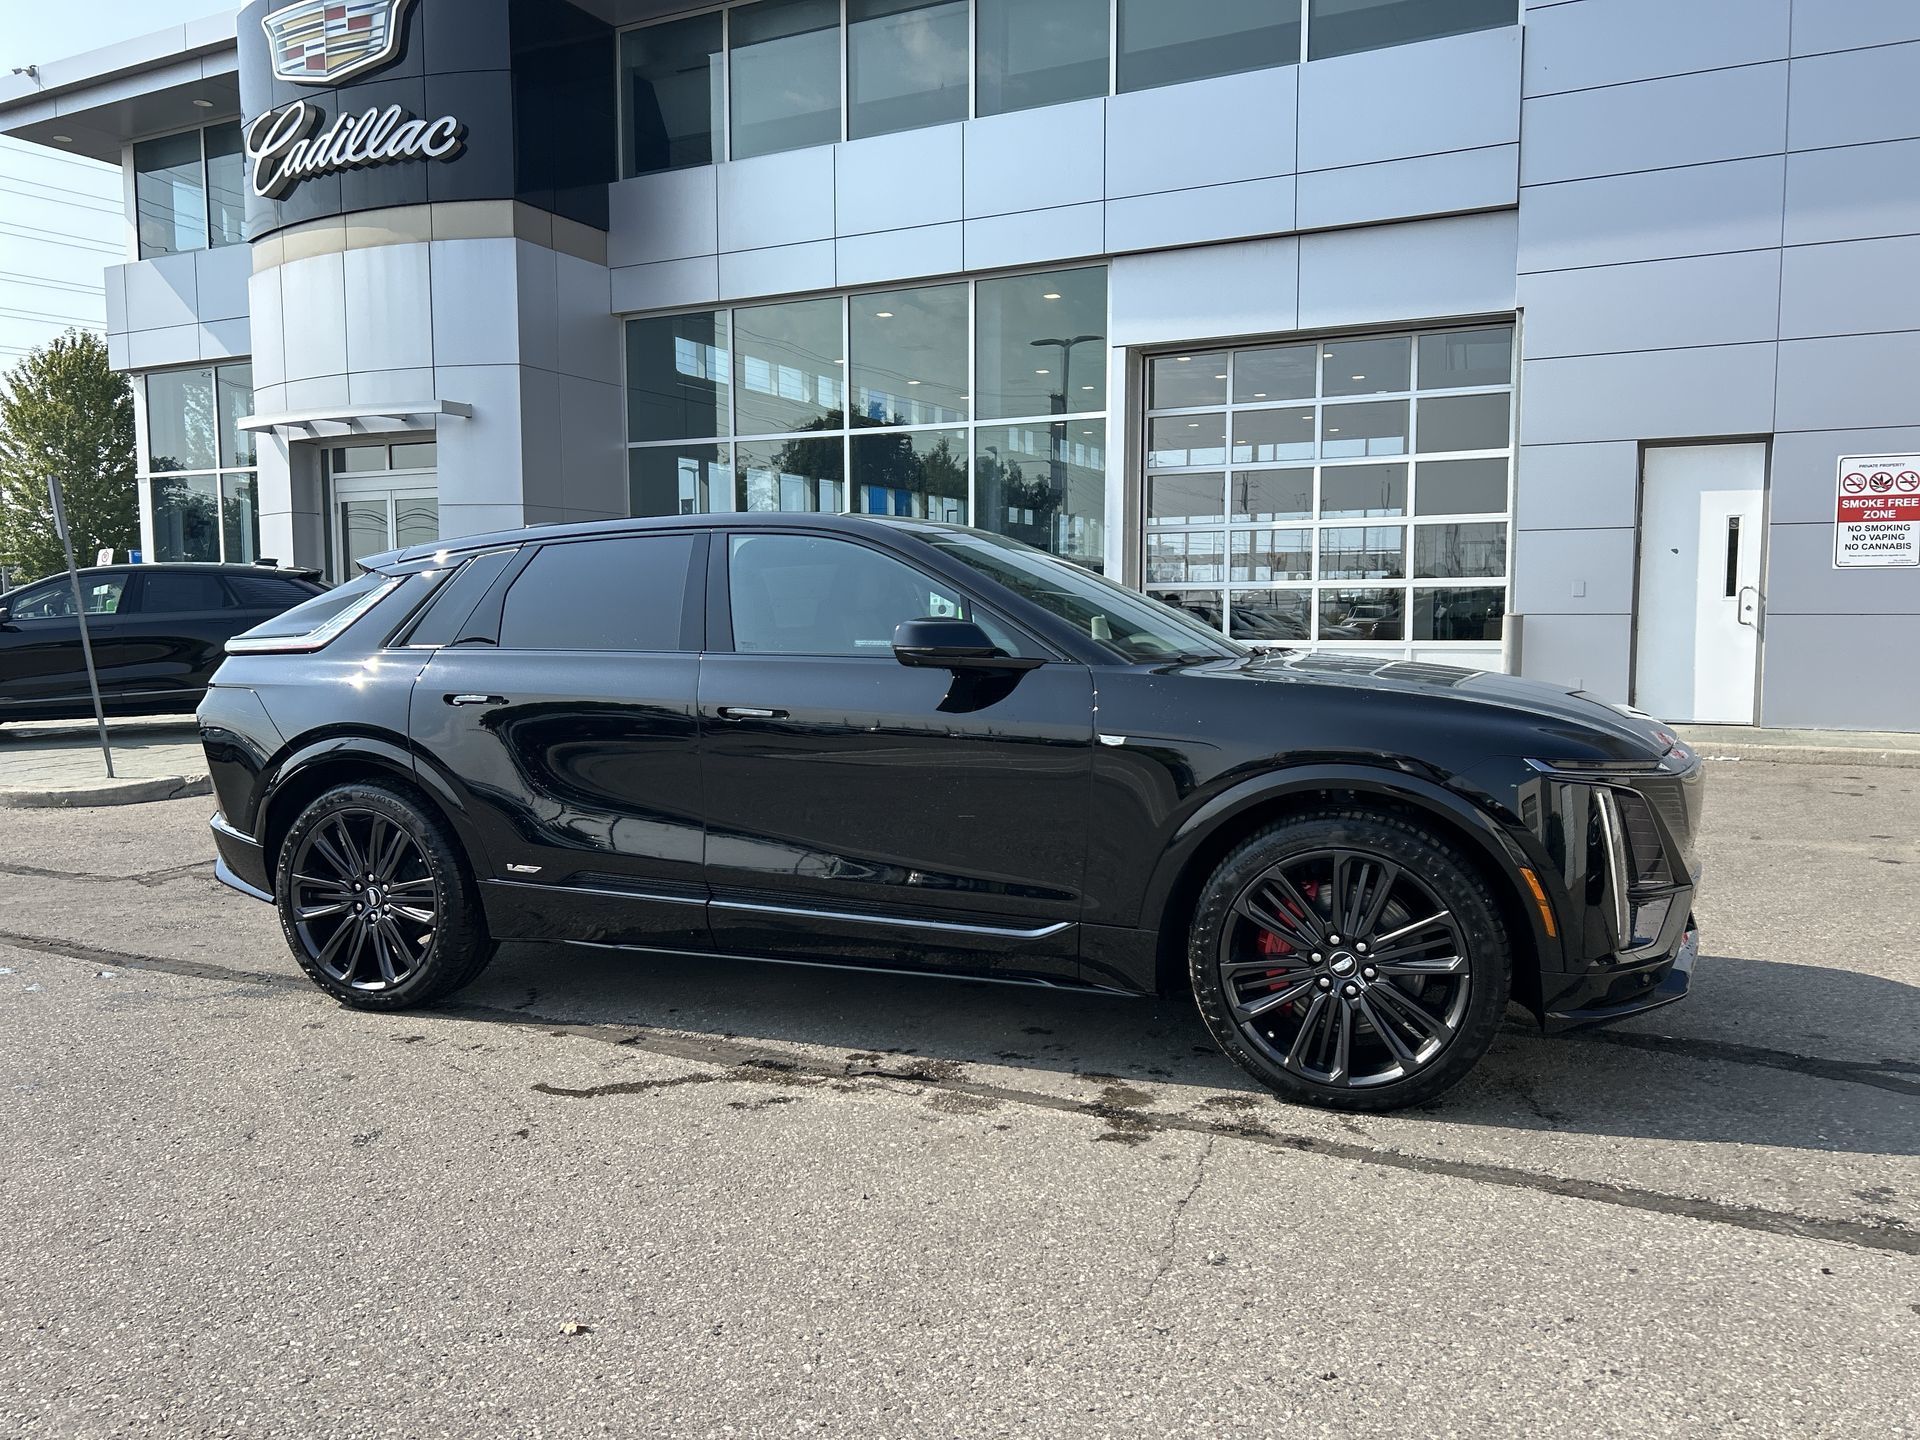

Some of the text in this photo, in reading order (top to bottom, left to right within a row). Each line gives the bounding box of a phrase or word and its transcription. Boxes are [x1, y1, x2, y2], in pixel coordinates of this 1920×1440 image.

[247, 100, 457, 197] Cadillac
[1842, 498, 1919, 508] SMOKE FREE
[1863, 510, 1897, 519] ZONE
[1864, 524, 1911, 532] SMOKING
[1869, 533, 1906, 541] VAPING
[1861, 542, 1911, 550] CANNABIS
